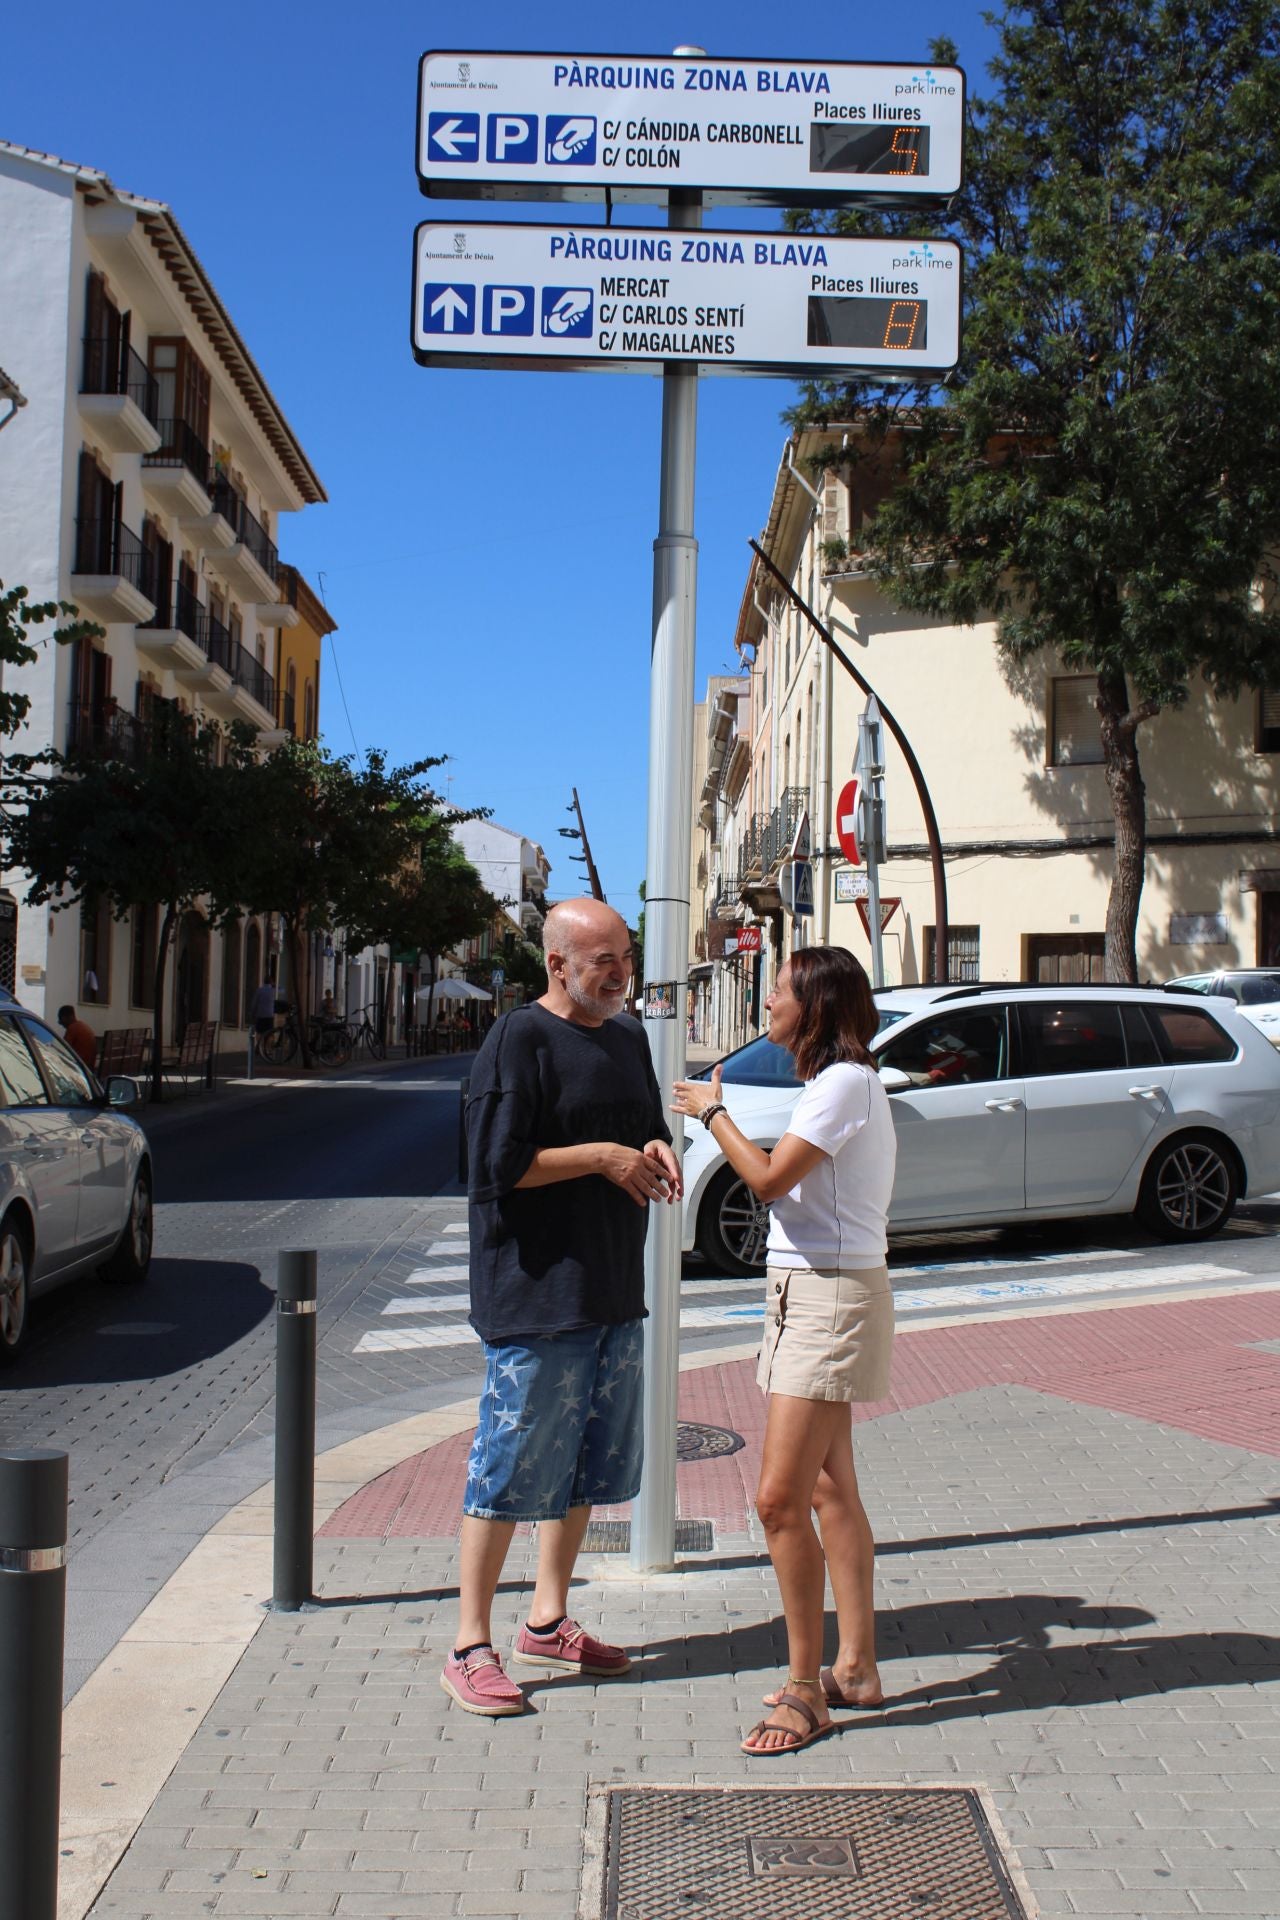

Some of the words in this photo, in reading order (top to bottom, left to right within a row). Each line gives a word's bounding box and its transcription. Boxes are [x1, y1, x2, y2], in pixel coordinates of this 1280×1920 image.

[429, 81, 468, 90] Ajuntament
[469, 81, 478, 89] de
[554, 61, 674, 90] PÀRQUING
[684, 68, 747, 92] ZONA
[757, 70, 831, 94] BLAVA
[814, 101, 866, 120] Places
[873, 103, 921, 121] lliures
[495, 117, 530, 160] P
[603, 120, 621, 140] C/
[626, 117, 701, 142] CÁNDIDA
[707, 123, 804, 145] CARBONELL
[602, 147, 620, 167] C/
[625, 144, 680, 168] COLÓN
[889, 128, 920, 175] 5
[424, 251, 463, 261] Ajuntament
[464, 252, 473, 260] de
[550, 232, 672, 262] PÀRQUING
[681, 241, 745, 265] ZONA
[754, 243, 828, 267] BLAVA
[600, 276, 670, 298] MERCAT
[811, 274, 864, 293] Places
[870, 276, 919, 295] lliures
[491, 289, 526, 332] P
[599, 304, 618, 324] C/
[622, 304, 688, 326] CARLOS
[694, 303, 746, 328] SENTÍ
[883, 300, 920, 349] 8
[598, 330, 617, 351] C/
[622, 331, 735, 355] MAGALLANES
[738, 930, 759, 950] illy
